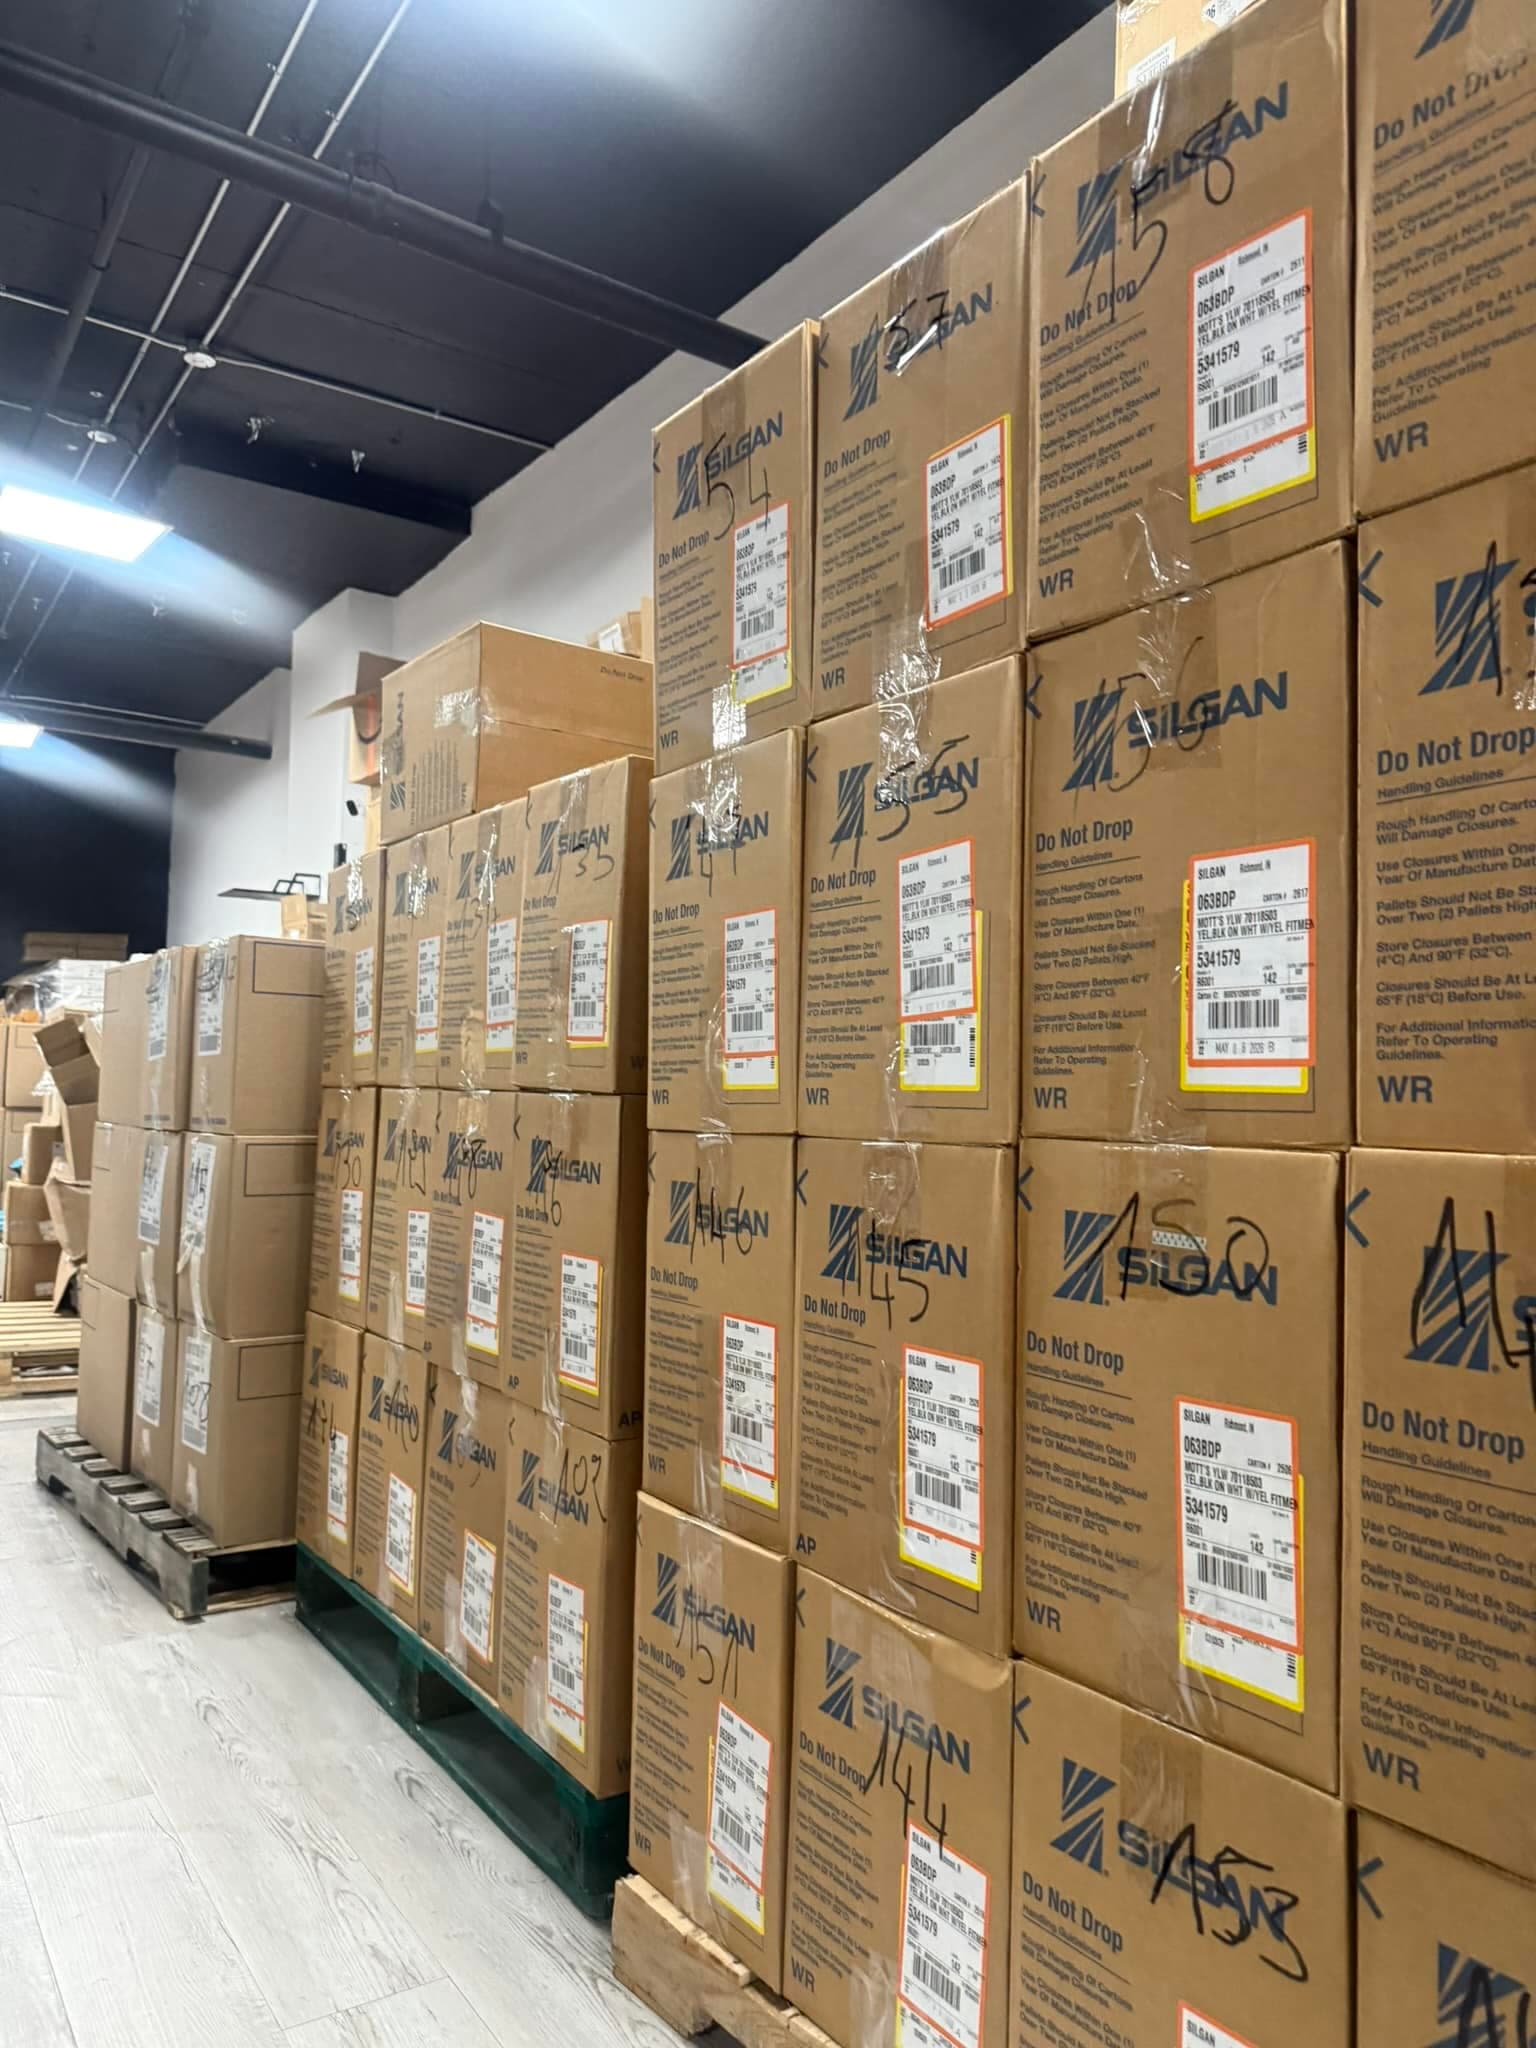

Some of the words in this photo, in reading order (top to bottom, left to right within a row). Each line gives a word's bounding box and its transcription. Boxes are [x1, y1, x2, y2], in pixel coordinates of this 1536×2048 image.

[1374, 119, 1404, 150] Do
[1413, 84, 1455, 128] Not
[1197, 265, 1225, 289] SILGAN
[1197, 341, 1240, 375] 5341579
[1261, 349, 1276, 366] 142
[708, 411, 783, 480] SILGAN
[824, 458, 838, 478] Do
[841, 444, 860, 468] Not
[863, 429, 891, 456] Drop
[1374, 421, 1428, 463] WR
[1038, 566, 1075, 599] WR
[822, 666, 846, 692] WR
[1127, 670, 1288, 749] SILGAN
[660, 729, 679, 751] WR
[1378, 750, 1408, 775] Do
[1418, 736, 1462, 768] Not
[1471, 727, 1536, 758] Drop
[1378, 782, 1431, 799] Handling
[1435, 768, 1504, 789] Guidelines
[1376, 817, 1416, 832] Rough
[1420, 808, 1476, 825] Handling
[1480, 804, 1495, 816] Of
[1036, 833, 1055, 853] Do
[1060, 824, 1088, 848] Not
[1093, 819, 1133, 842] Drop
[1376, 833, 1398, 844] Will
[1402, 825, 1453, 842] Damage
[1376, 861, 1399, 872] Use
[1403, 853, 1459, 868] Closures
[1462, 847, 1504, 860] Within
[811, 877, 824, 894] Do
[828, 873, 846, 891] Not
[850, 869, 876, 888] Drop
[1198, 866, 1225, 880] SILGAN
[1376, 875, 1404, 885] Year
[1408, 871, 1421, 882] Of
[1426, 861, 1508, 879] Manufacture
[1198, 890, 1236, 911] 063BDP
[1376, 900, 1417, 911] Pallets
[1420, 893, 1465, 908] Should
[1469, 890, 1492, 900] Not
[1496, 888, 1514, 899] Be
[1198, 915, 1224, 929] MOTT'S
[1226, 913, 1242, 925] YLW
[1228, 926, 1238, 936] ON
[1241, 923, 1257, 935] WHT
[1376, 942, 1409, 952] Store
[1412, 937, 1468, 950] Closures
[1472, 932, 1532, 945] Between
[1197, 949, 1240, 968] 5341579
[1408, 953, 1433, 964] And
[1263, 972, 1277, 984] 142
[1448, 991, 1491, 1002] Before
[1376, 1036, 1409, 1047] Refer
[1413, 1036, 1428, 1046] To
[1433, 1034, 1498, 1047] Operating
[652, 1087, 670, 1107] WR
[806, 1086, 830, 1107] WR
[1034, 1087, 1067, 1109] WR
[1377, 1075, 1433, 1103] WR
[865, 1231, 968, 1279] SILGAN
[1117, 1246, 1278, 1306] SILGAN
[804, 1294, 817, 1313] Do
[821, 1298, 838, 1318] Not
[841, 1302, 866, 1327] Drop
[1027, 1330, 1046, 1354] Do
[1052, 1336, 1080, 1361] Not
[1084, 1342, 1124, 1376] Drop
[1184, 1408, 1211, 1425] SILGAN
[908, 1425, 936, 1447] 5341579
[1363, 1401, 1394, 1432] Do
[1404, 1408, 1448, 1444] Not
[1458, 1420, 1525, 1464] Drop
[1184, 1435, 1222, 1459] 063BDP
[648, 1452, 667, 1476] WR
[1185, 1496, 1228, 1523] 5341579
[796, 1534, 817, 1556] AP
[1250, 1541, 1264, 1555] 142
[1026, 1597, 1061, 1633] WR
[861, 1685, 970, 1775] SILGAN
[800, 1731, 813, 1755] Do
[816, 1741, 836, 1771] Not
[839, 1757, 866, 1794] Drop
[1363, 1742, 1420, 1791] WR
[633, 1830, 653, 1858] WR
[908, 1903, 938, 1937] 5341579
[1022, 1871, 1043, 1902] Do
[1048, 1886, 1076, 1924] Not
[1081, 1906, 1123, 1953] Drop
[791, 1956, 817, 1995] WR
[1187, 2020, 1215, 2048] SILGAN
